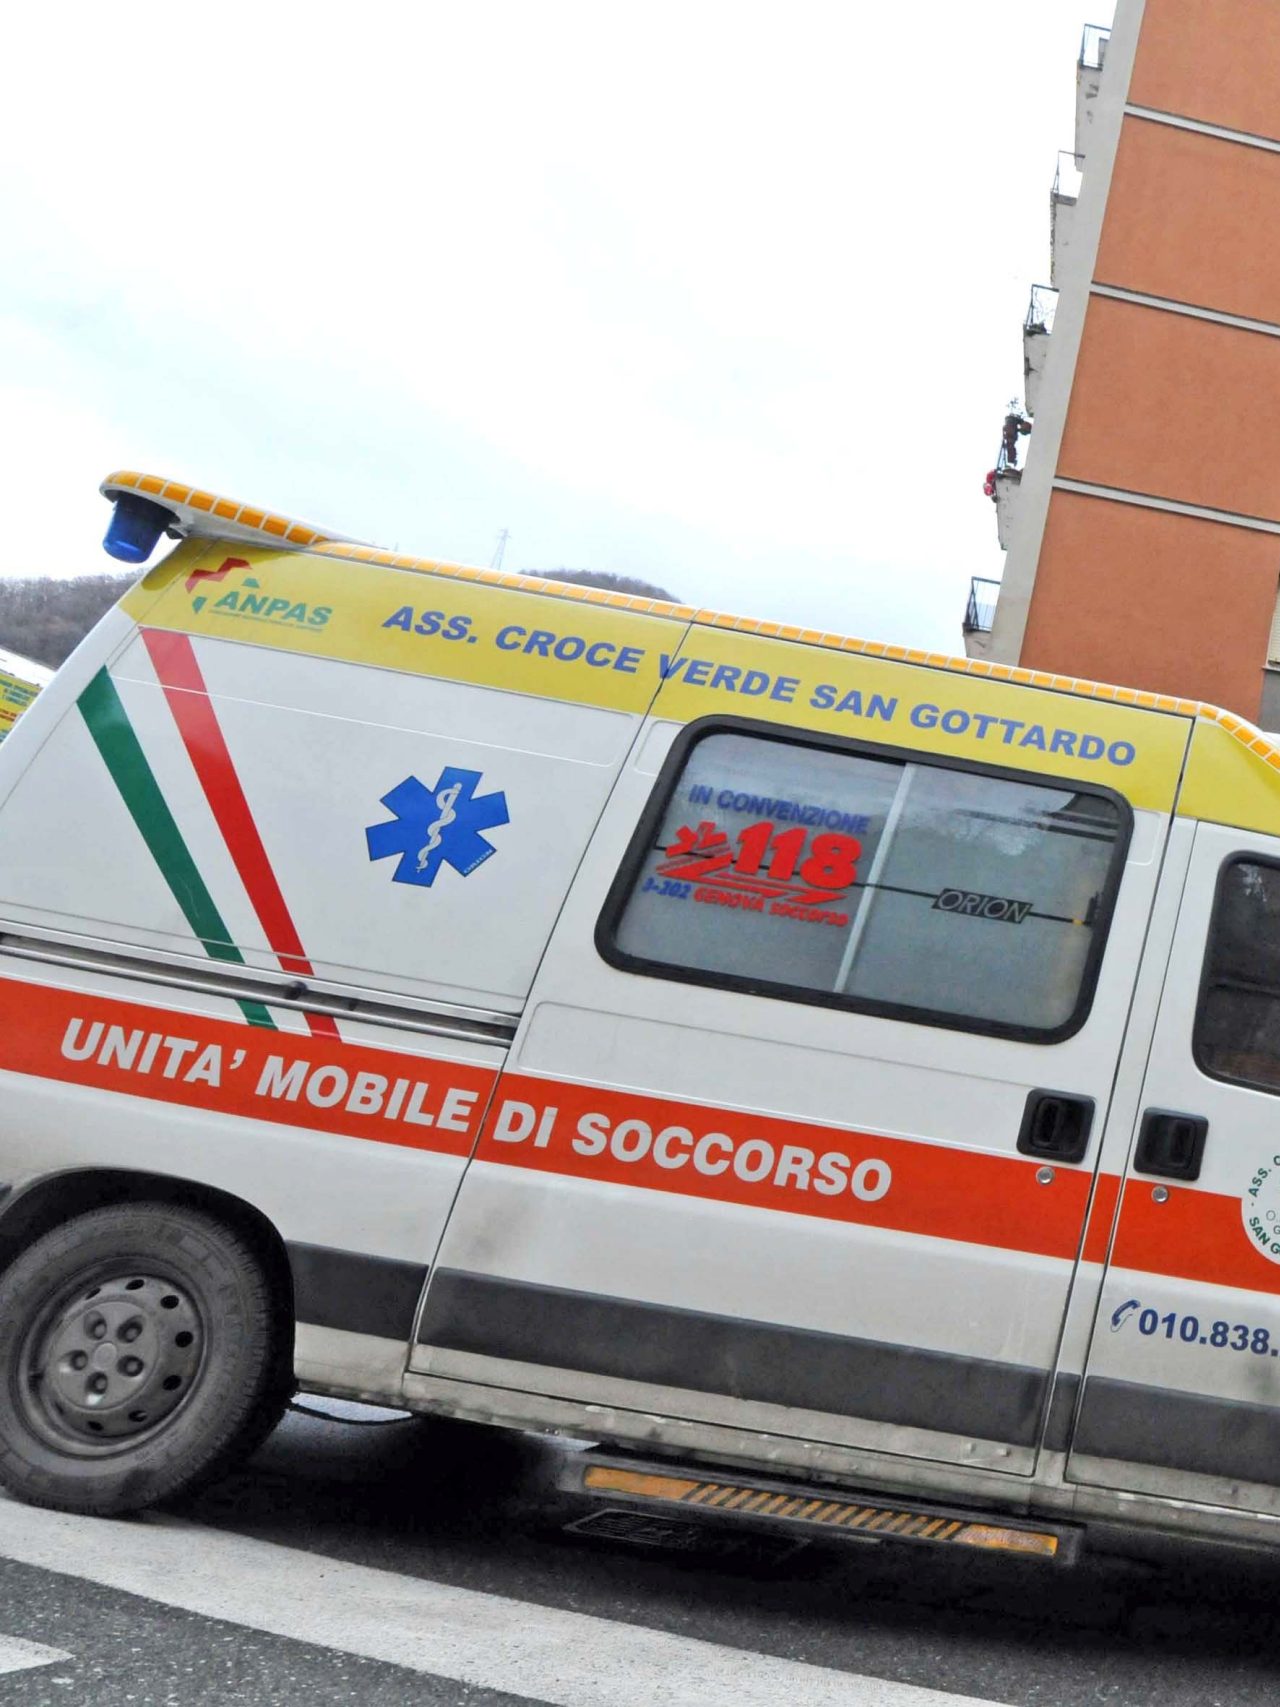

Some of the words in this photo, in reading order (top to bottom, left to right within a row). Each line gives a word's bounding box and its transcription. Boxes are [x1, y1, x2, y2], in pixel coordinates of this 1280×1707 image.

[213, 591, 333, 626] ANPAS
[382, 606, 478, 643] ASS.
[495, 626, 645, 673] CROCE
[659, 654, 800, 703] VERDE
[810, 684, 898, 721] SAN
[910, 704, 1136, 767] GOTTARDO
[688, 784, 714, 804] IN
[717, 790, 871, 834] CONVENZIONE
[735, 821, 862, 890] 118
[694, 887, 765, 912] GENOVA
[938, 891, 1031, 922] ORION
[60, 1018, 246, 1087] UNITA'
[255, 1055, 479, 1132] MOBILE
[493, 1100, 558, 1148] DI
[572, 1112, 892, 1202] SOCCORSO
[1248, 1167, 1272, 1198] ASS.
[1249, 1217, 1270, 1246] SAN
